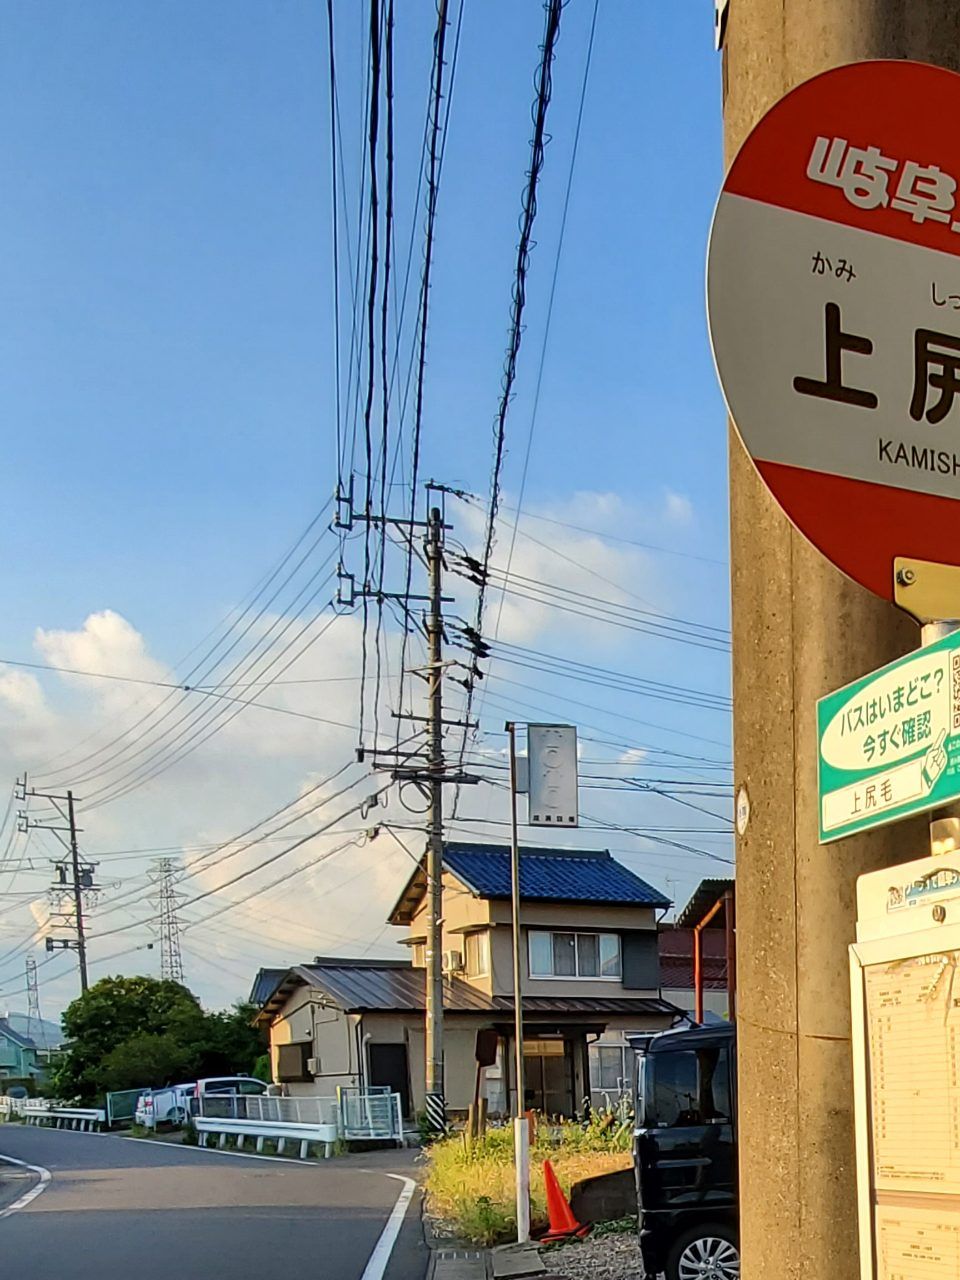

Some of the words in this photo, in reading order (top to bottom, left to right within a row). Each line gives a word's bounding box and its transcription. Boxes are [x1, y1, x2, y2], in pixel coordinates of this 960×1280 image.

[810, 251, 857, 284] かみ
[840, 667, 945, 738] バスはいまどこ？
[862, 709, 933, 763] 今すぐ確認
[850, 778, 894, 815] 上尻毛
